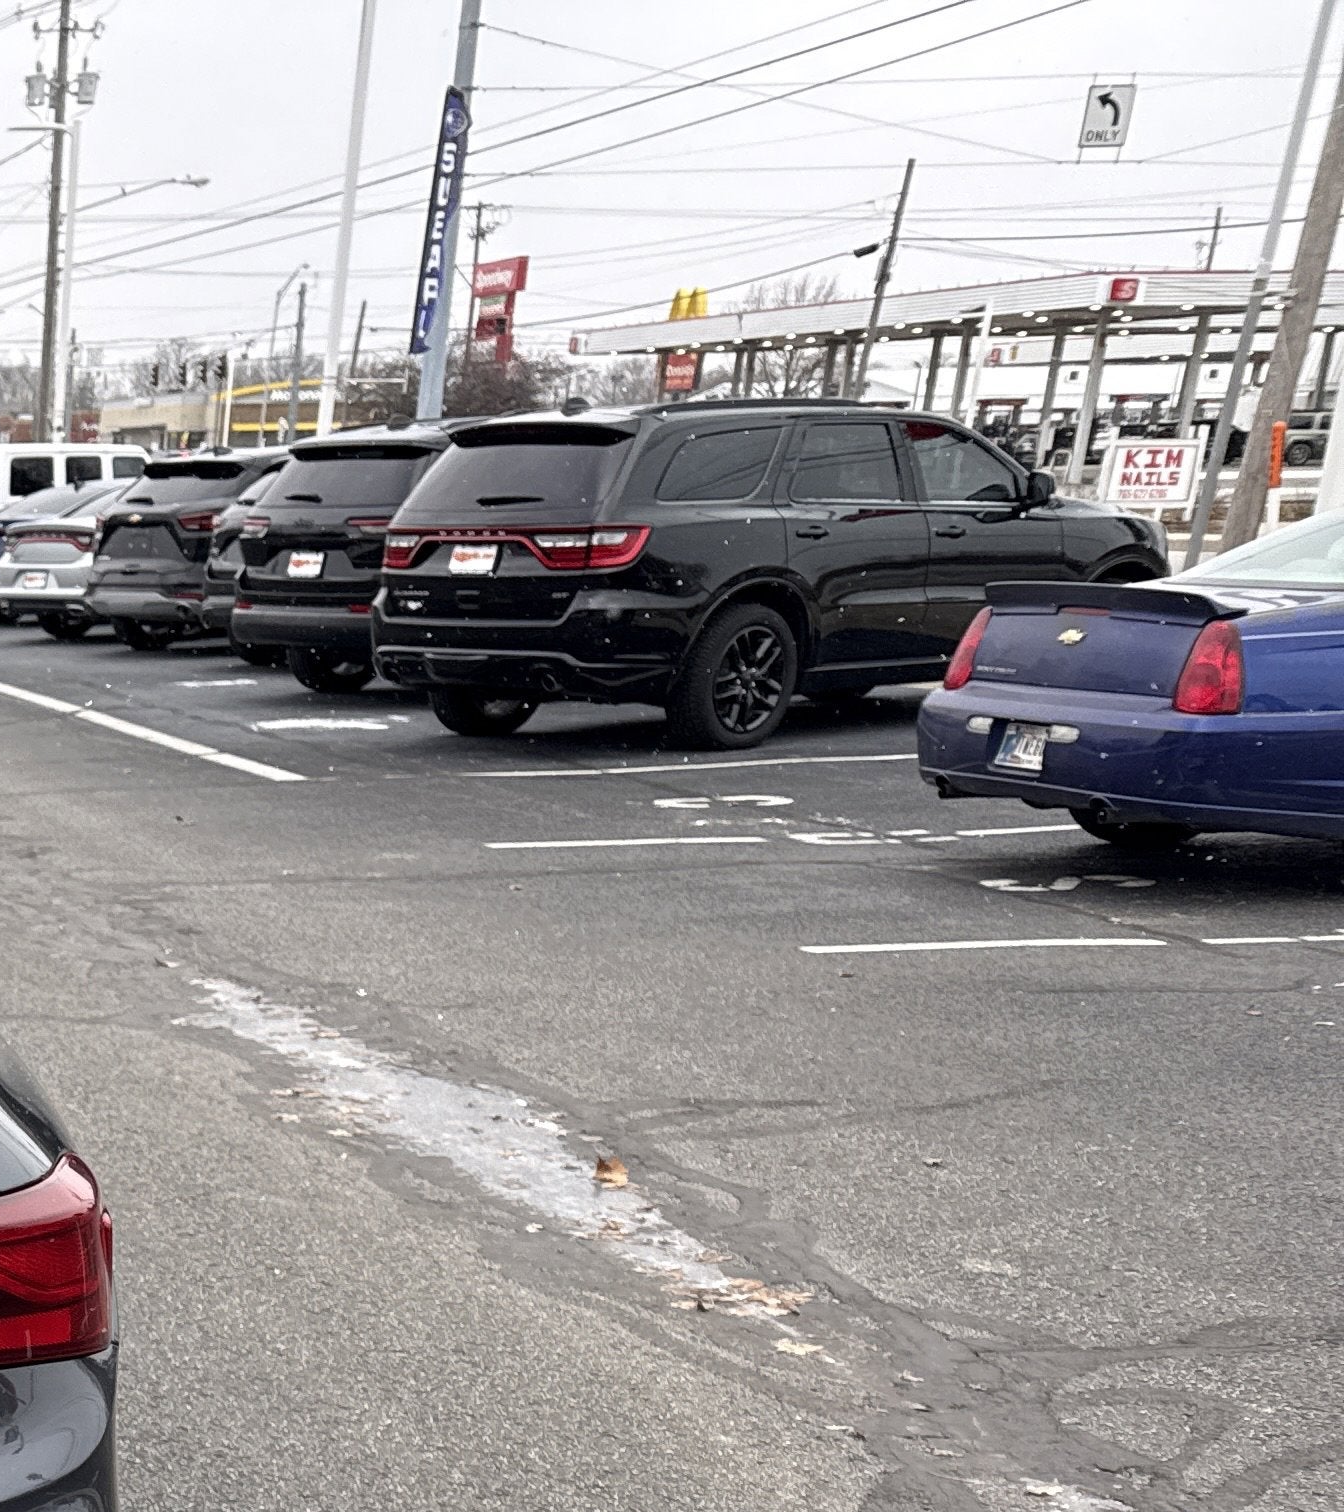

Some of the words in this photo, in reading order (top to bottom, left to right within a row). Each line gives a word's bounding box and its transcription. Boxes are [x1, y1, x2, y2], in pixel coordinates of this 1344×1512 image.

[1085, 130, 1120, 142] ONLY
[1123, 448, 1184, 469] KIM
[1119, 471, 1181, 486] NAILS
